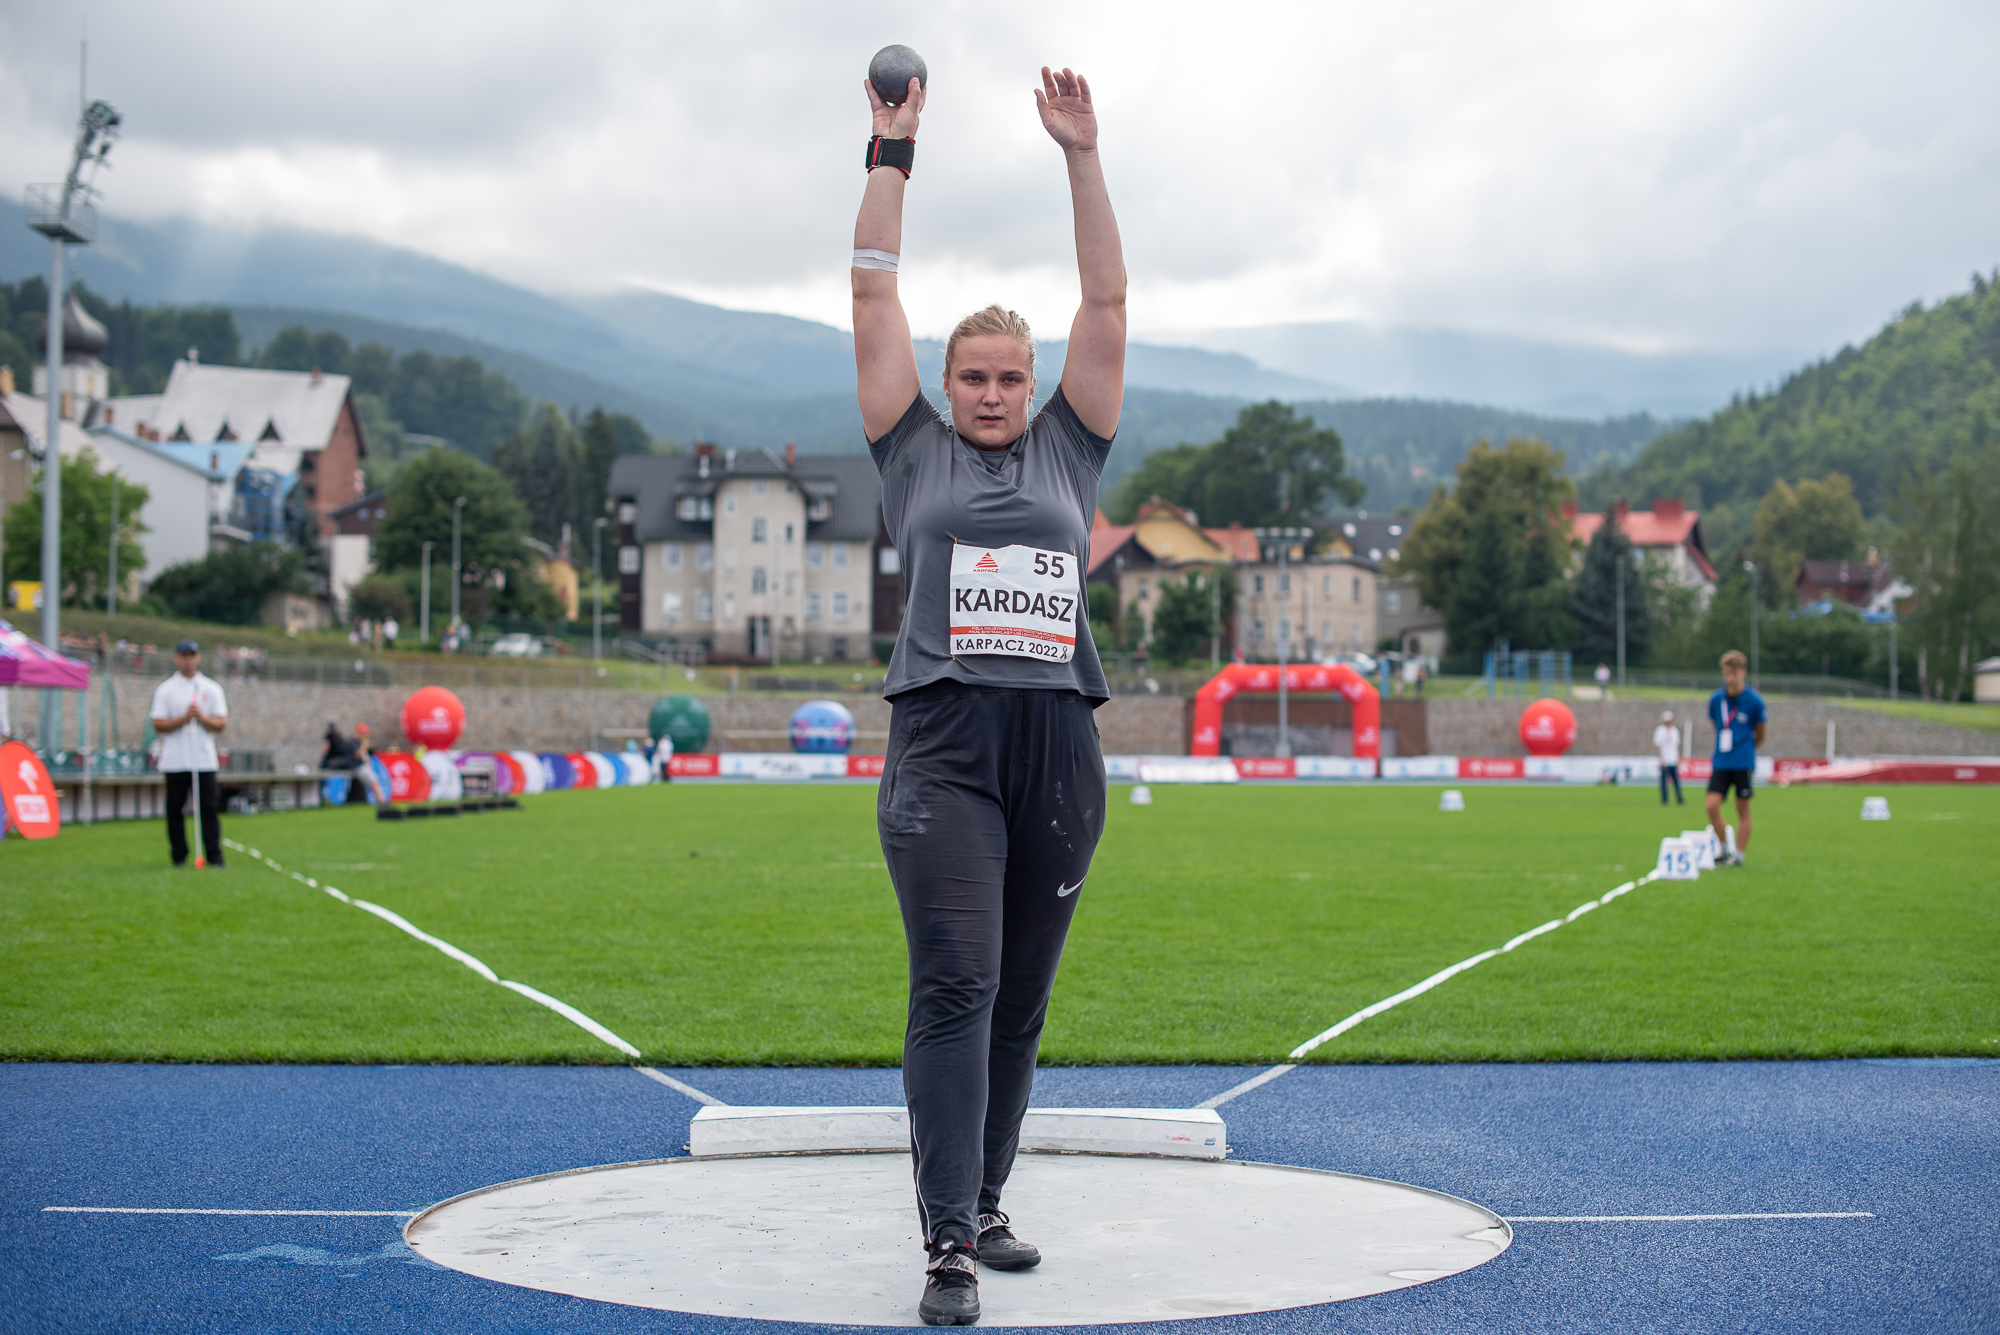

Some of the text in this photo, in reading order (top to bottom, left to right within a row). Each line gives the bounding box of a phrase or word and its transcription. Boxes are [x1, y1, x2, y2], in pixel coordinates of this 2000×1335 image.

[1033, 552, 1065, 579] 55
[955, 588, 1074, 623] KARDASZ
[956, 638, 1058, 658] KARPACZ 2022
[1664, 852, 1691, 874] 15
